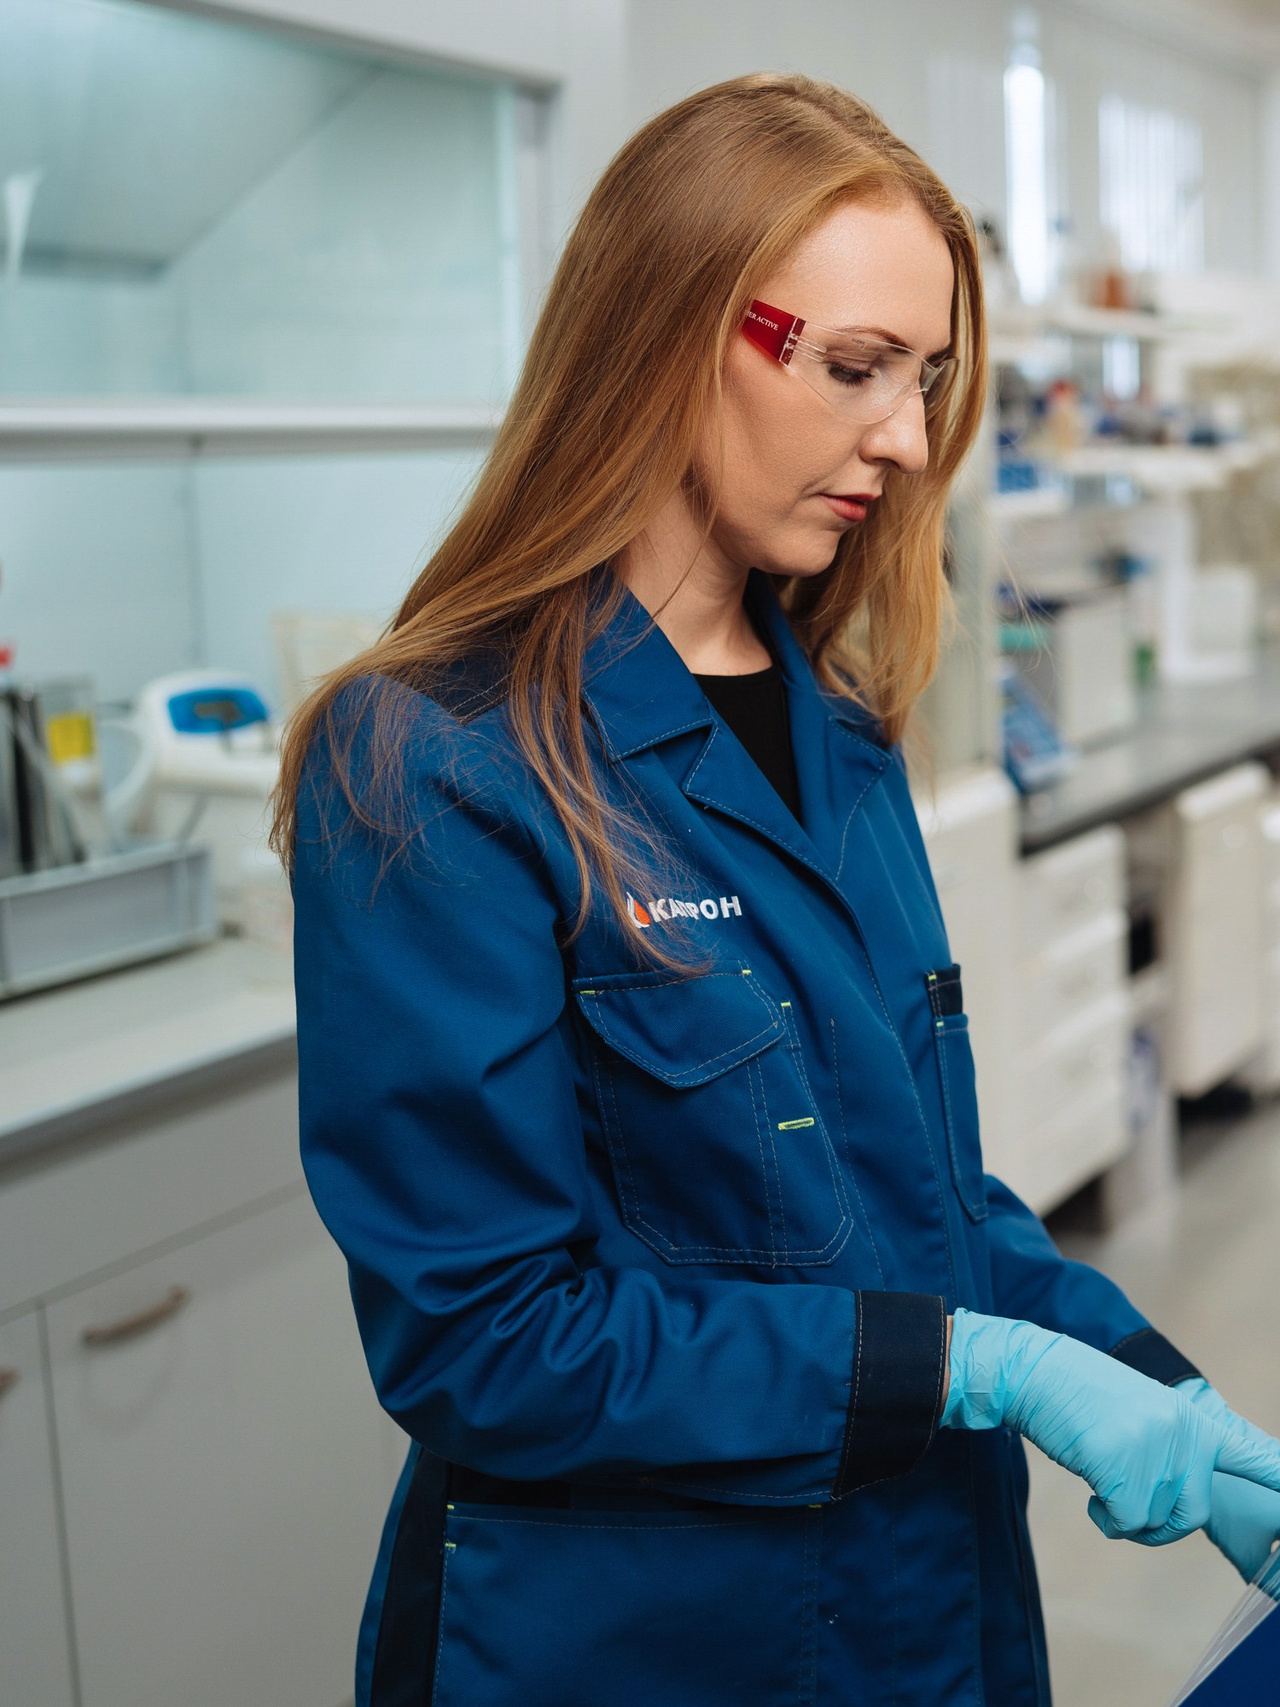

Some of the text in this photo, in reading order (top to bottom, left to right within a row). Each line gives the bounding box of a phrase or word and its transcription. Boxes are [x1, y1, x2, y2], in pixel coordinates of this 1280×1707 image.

[747, 310, 778, 330] ER ACTIVE
[648, 895, 743, 923] КАПРОН
